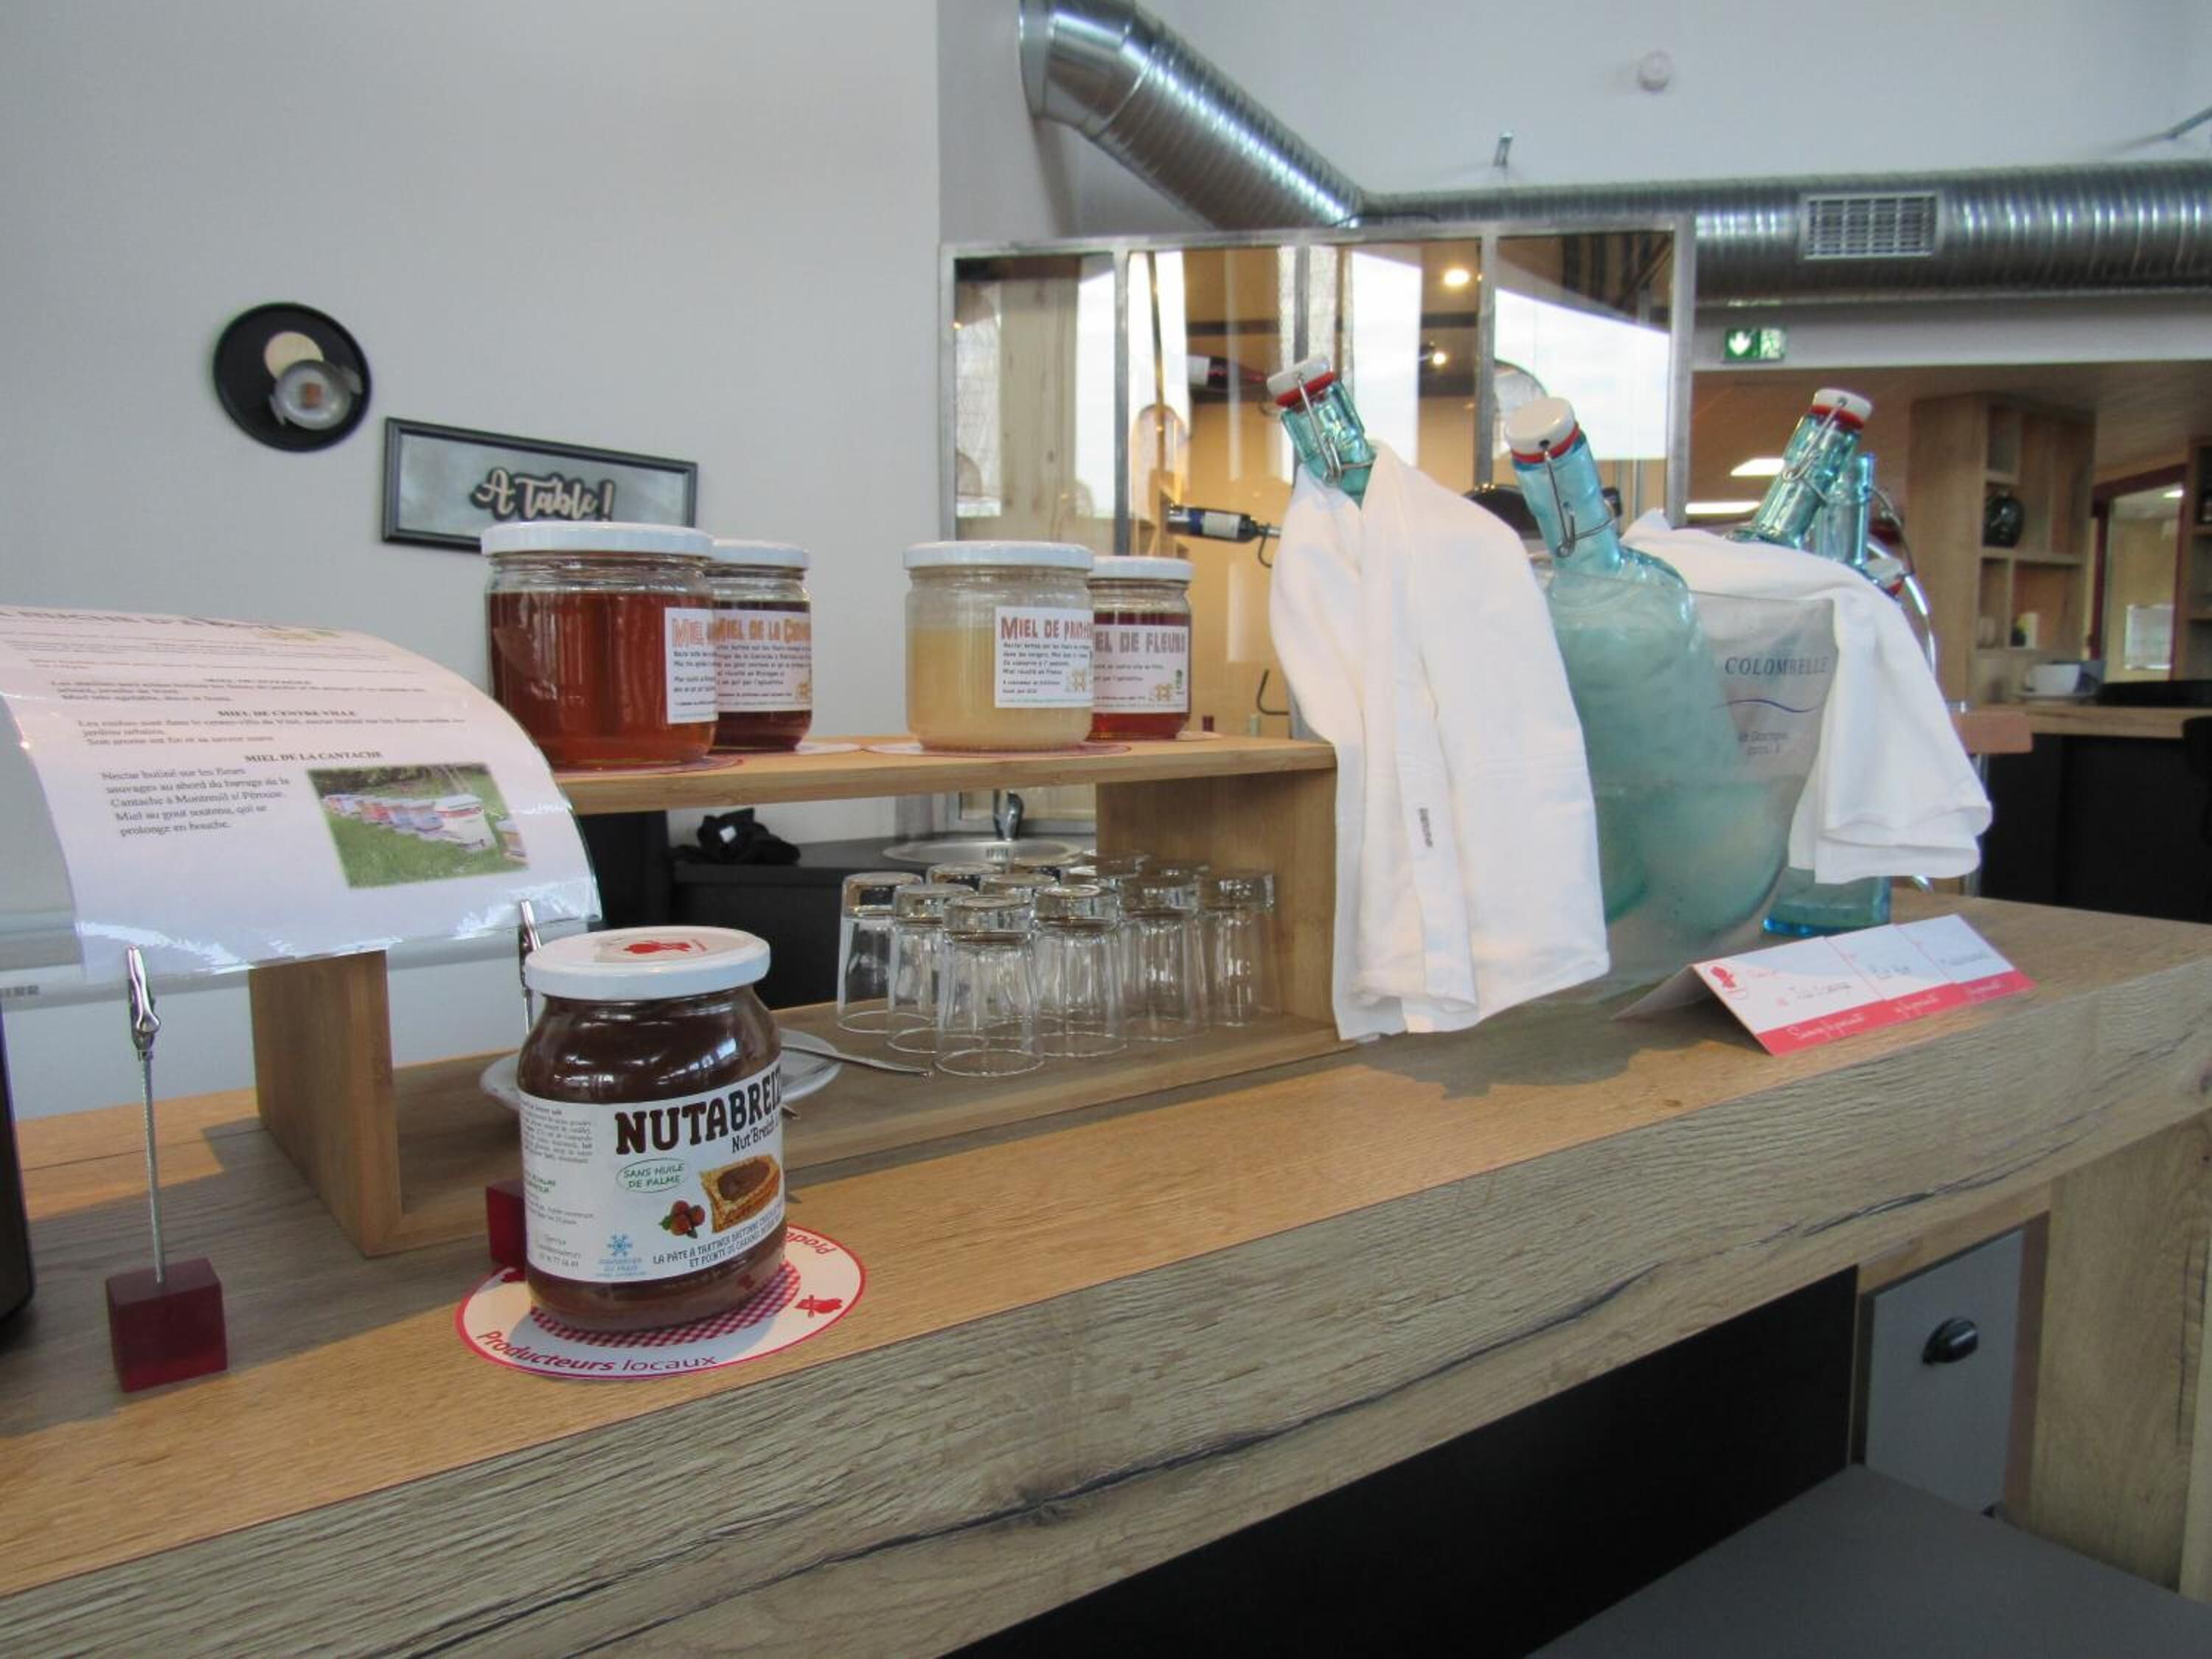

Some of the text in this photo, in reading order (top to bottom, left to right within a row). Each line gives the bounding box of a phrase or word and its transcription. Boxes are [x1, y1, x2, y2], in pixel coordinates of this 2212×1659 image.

[471, 467, 515, 520] A
[1001, 616, 1039, 640] MIEL
[1043, 619, 1060, 639] DE
[1119, 631, 1139, 654] DE
[244, 751, 382, 763] MIEL DE LA CANTACHE
[623, 1163, 684, 1179] SANS HUILE
[627, 1175, 681, 1189] DE PALME
[653, 1255, 664, 1265] LA
[689, 1257, 699, 1268] ET
[476, 1329, 717, 1371] Producteurs locaux
